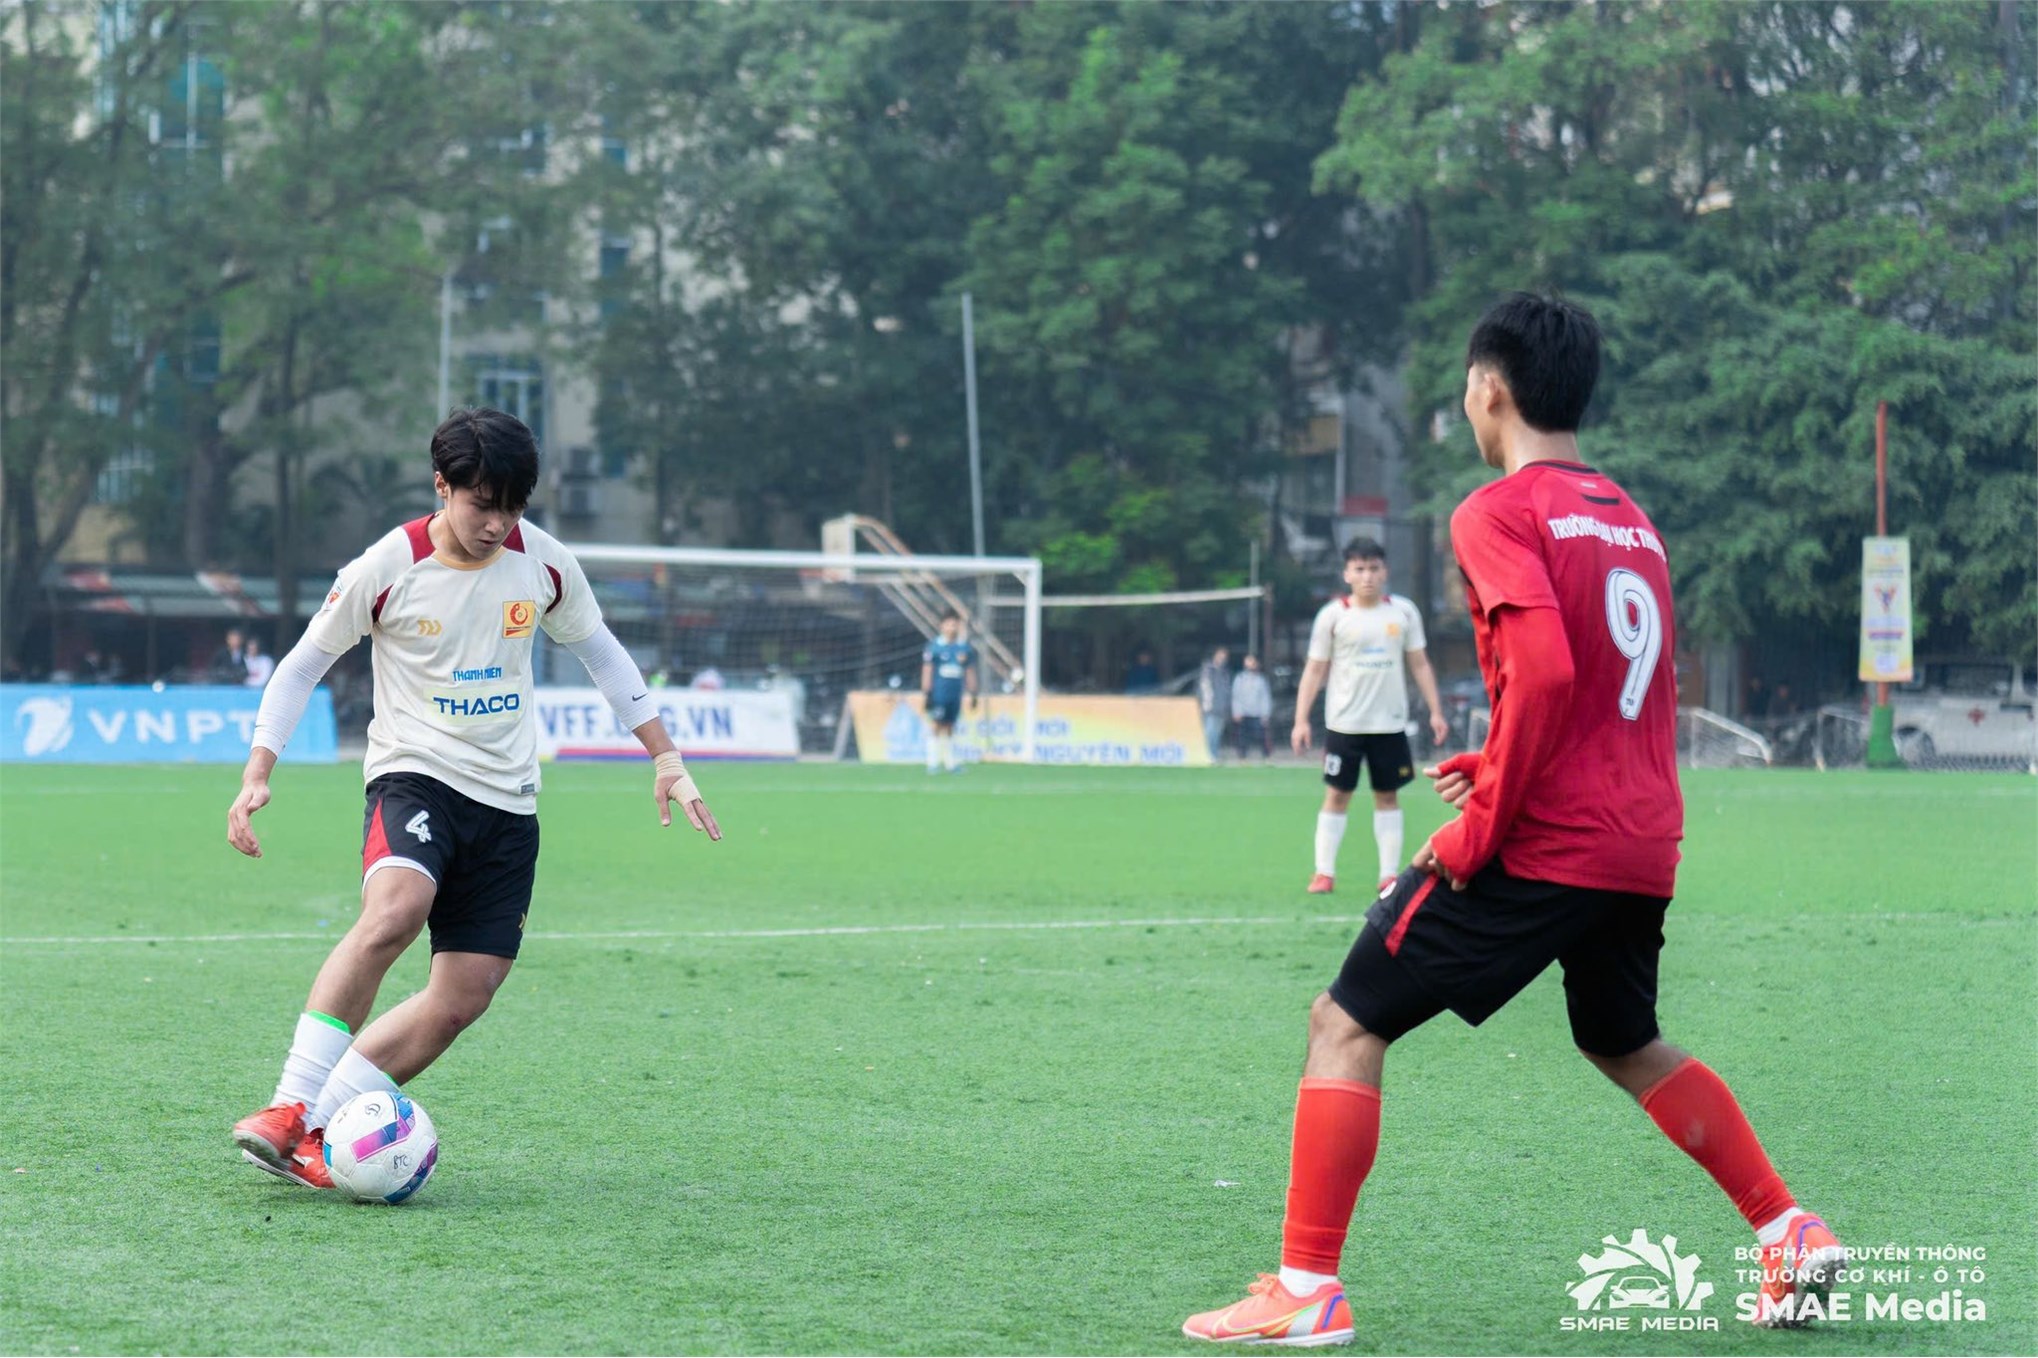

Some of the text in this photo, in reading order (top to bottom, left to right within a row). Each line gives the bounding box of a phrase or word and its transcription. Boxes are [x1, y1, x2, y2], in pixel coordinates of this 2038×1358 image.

[1610, 526, 1641, 551] HỌC
[1605, 566, 1663, 721] 9
[453, 669, 484, 682] THANH
[433, 692, 520, 716] THACO
[87, 709, 257, 744] VNPT
[405, 809, 432, 844] 4
